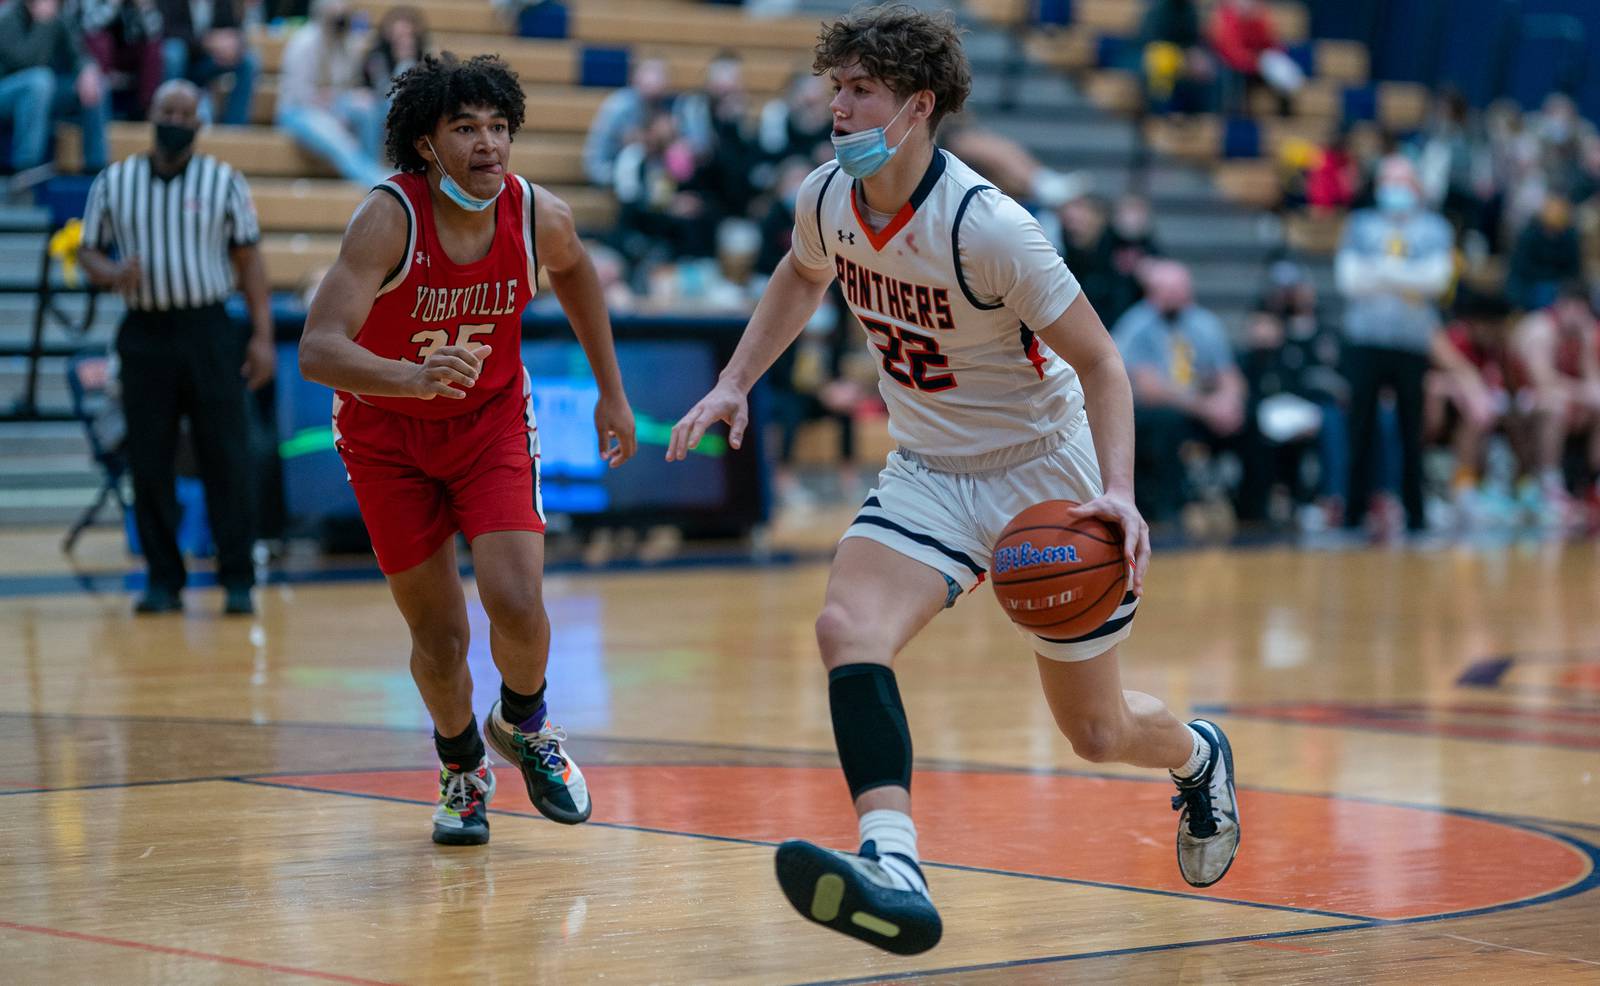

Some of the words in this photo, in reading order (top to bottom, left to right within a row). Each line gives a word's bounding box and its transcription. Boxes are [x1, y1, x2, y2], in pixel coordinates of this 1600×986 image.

[410, 279, 518, 322] YORKVILLE
[834, 253, 956, 330] PANTHERS
[399, 323, 496, 376] 35
[858, 315, 958, 393] 22
[994, 541, 1083, 574] Wilson
[1005, 587, 1083, 610] VLUTON
